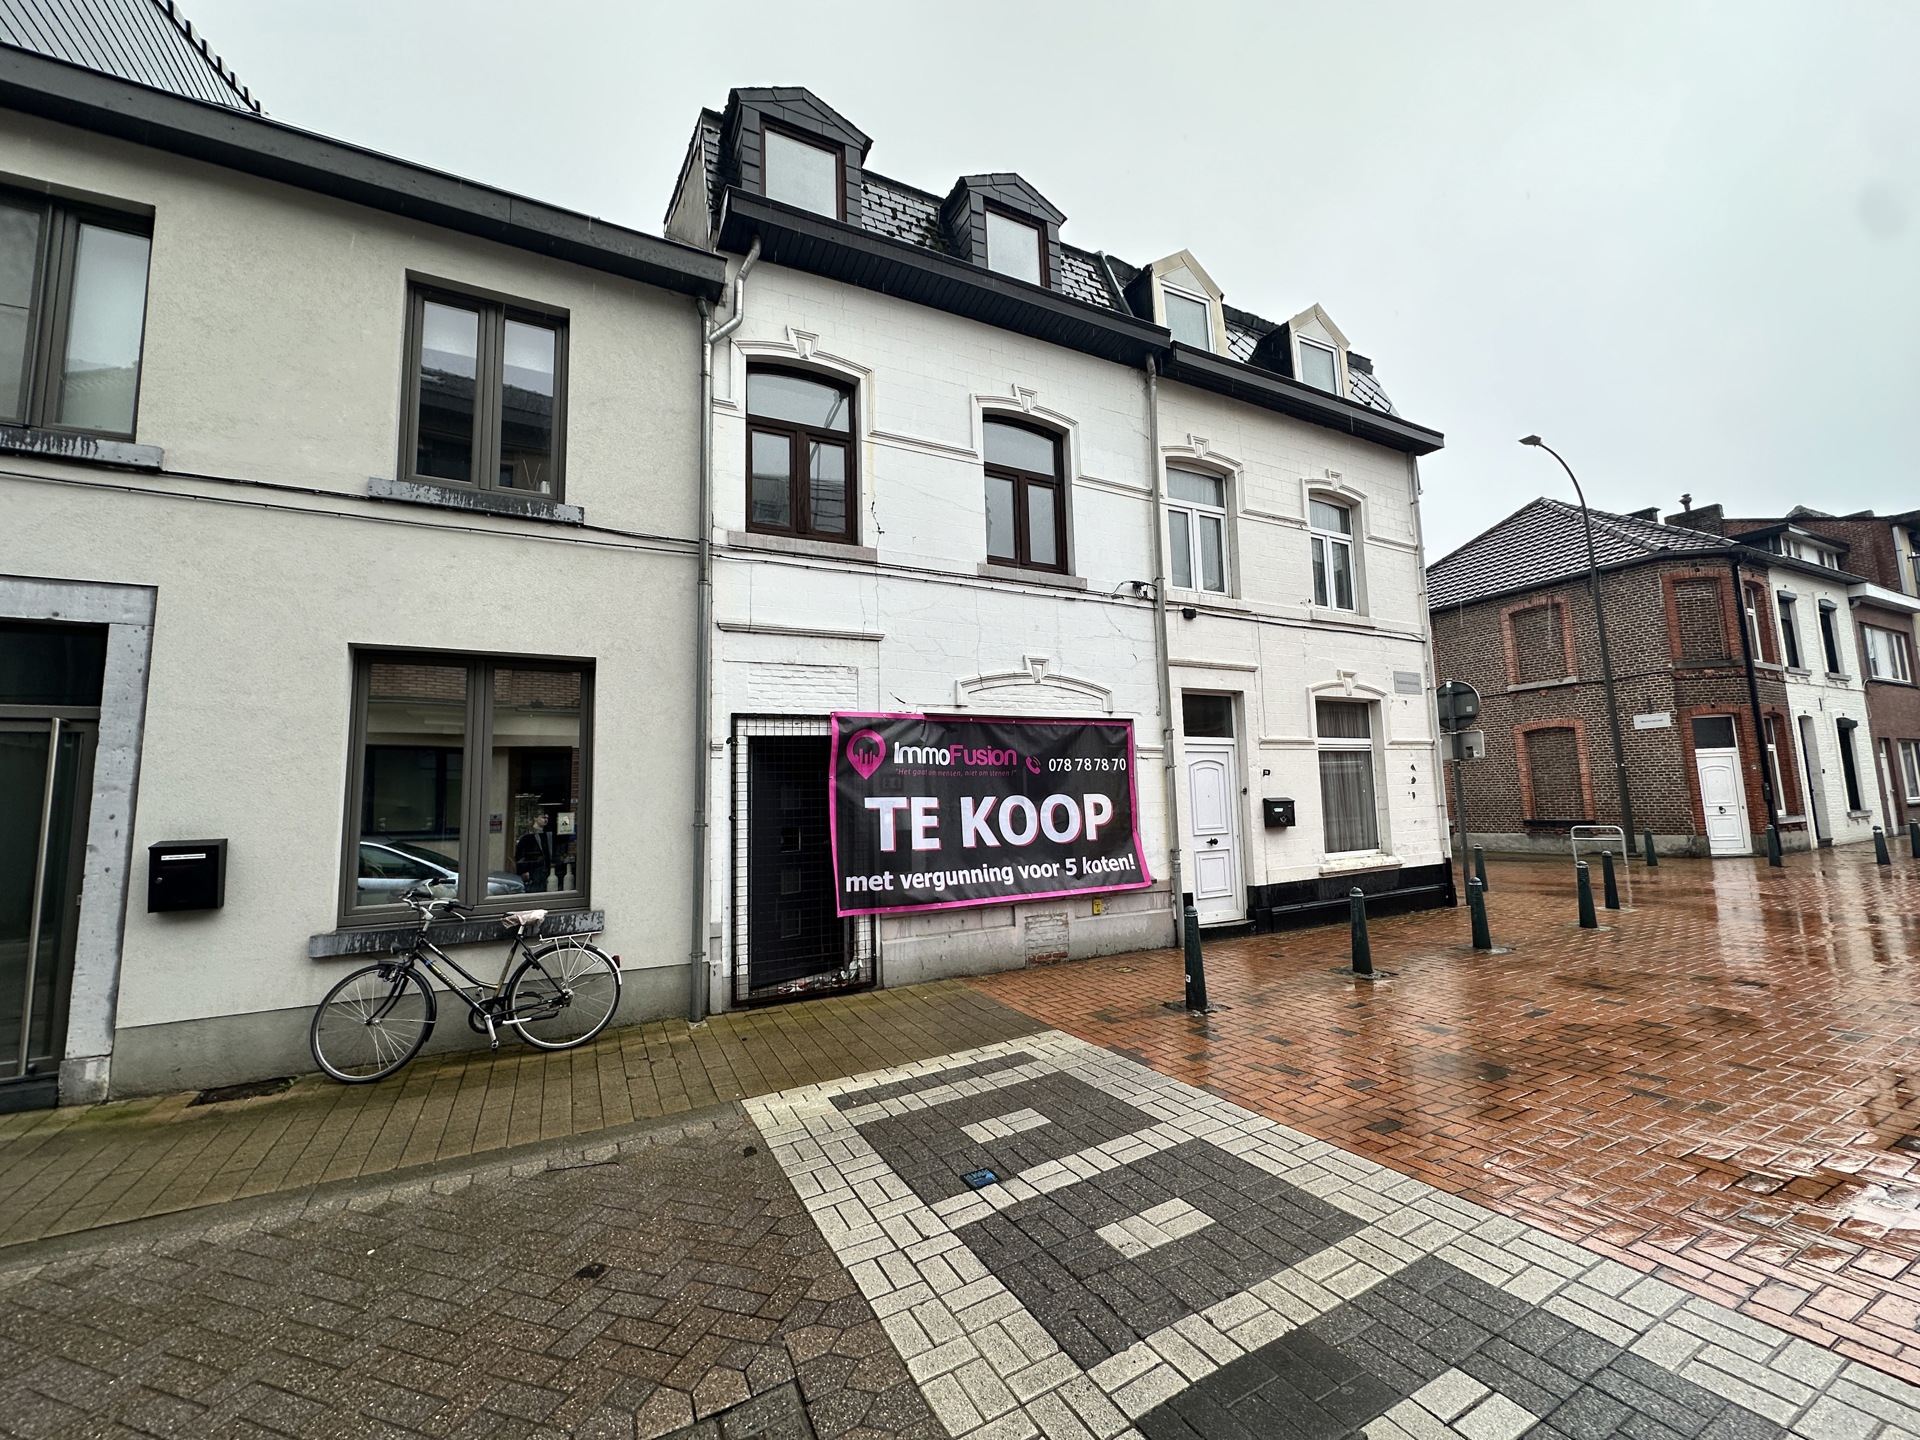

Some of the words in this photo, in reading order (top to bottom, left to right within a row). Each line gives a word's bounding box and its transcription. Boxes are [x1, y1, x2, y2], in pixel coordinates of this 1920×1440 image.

[894, 741, 1017, 766] ImmoFusion
[1048, 758, 1072, 772] 078
[1075, 758, 1092, 771] 78
[1094, 758, 1109, 771] 78
[1111, 758, 1127, 771] 70
[864, 796, 942, 853] TE
[960, 793, 1114, 847] KOOP
[845, 871, 894, 893] met
[899, 863, 1014, 892] vergunning
[1017, 862, 1060, 879] voor
[1065, 858, 1077, 876] 5
[1082, 853, 1136, 875] koten!
